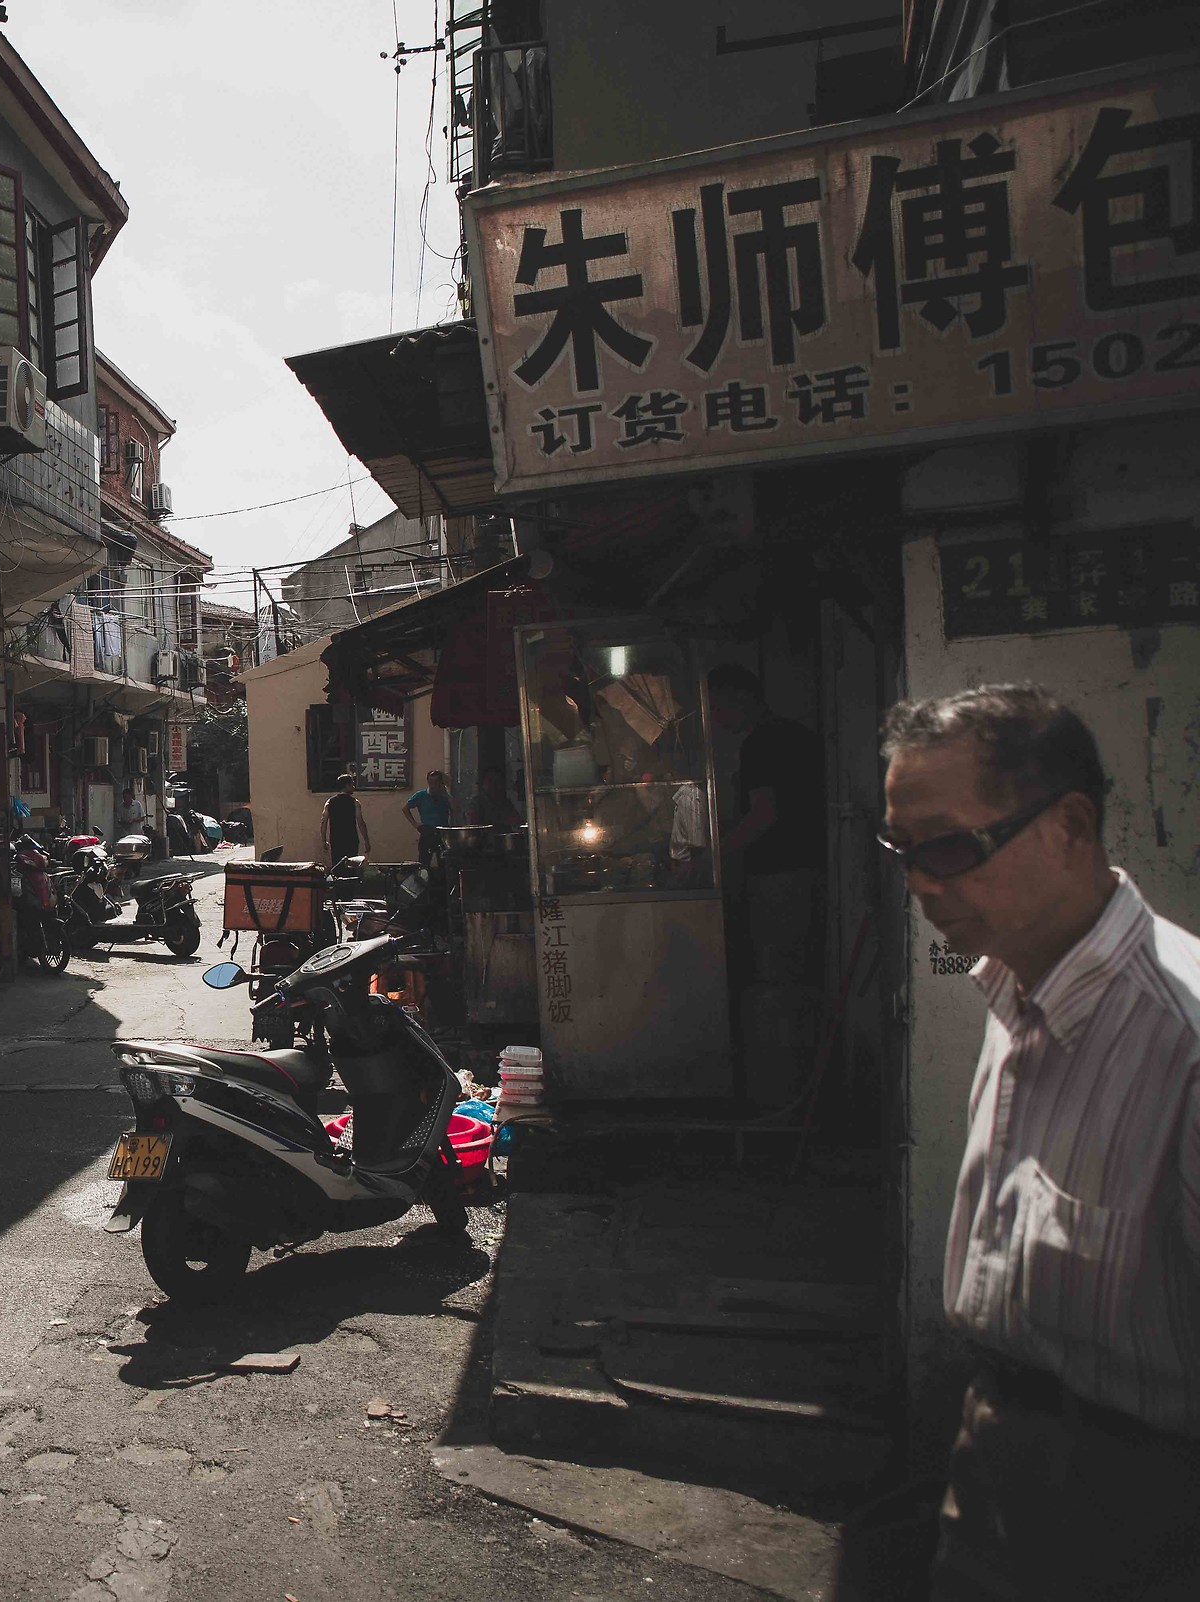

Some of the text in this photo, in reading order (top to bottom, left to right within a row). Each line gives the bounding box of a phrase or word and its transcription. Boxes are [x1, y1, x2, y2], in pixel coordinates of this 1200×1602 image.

[513, 107, 1200, 392] 朱师傅包
[977, 322, 1200, 396] 1502
[538, 897, 574, 1024] 隆江猪脚饭
